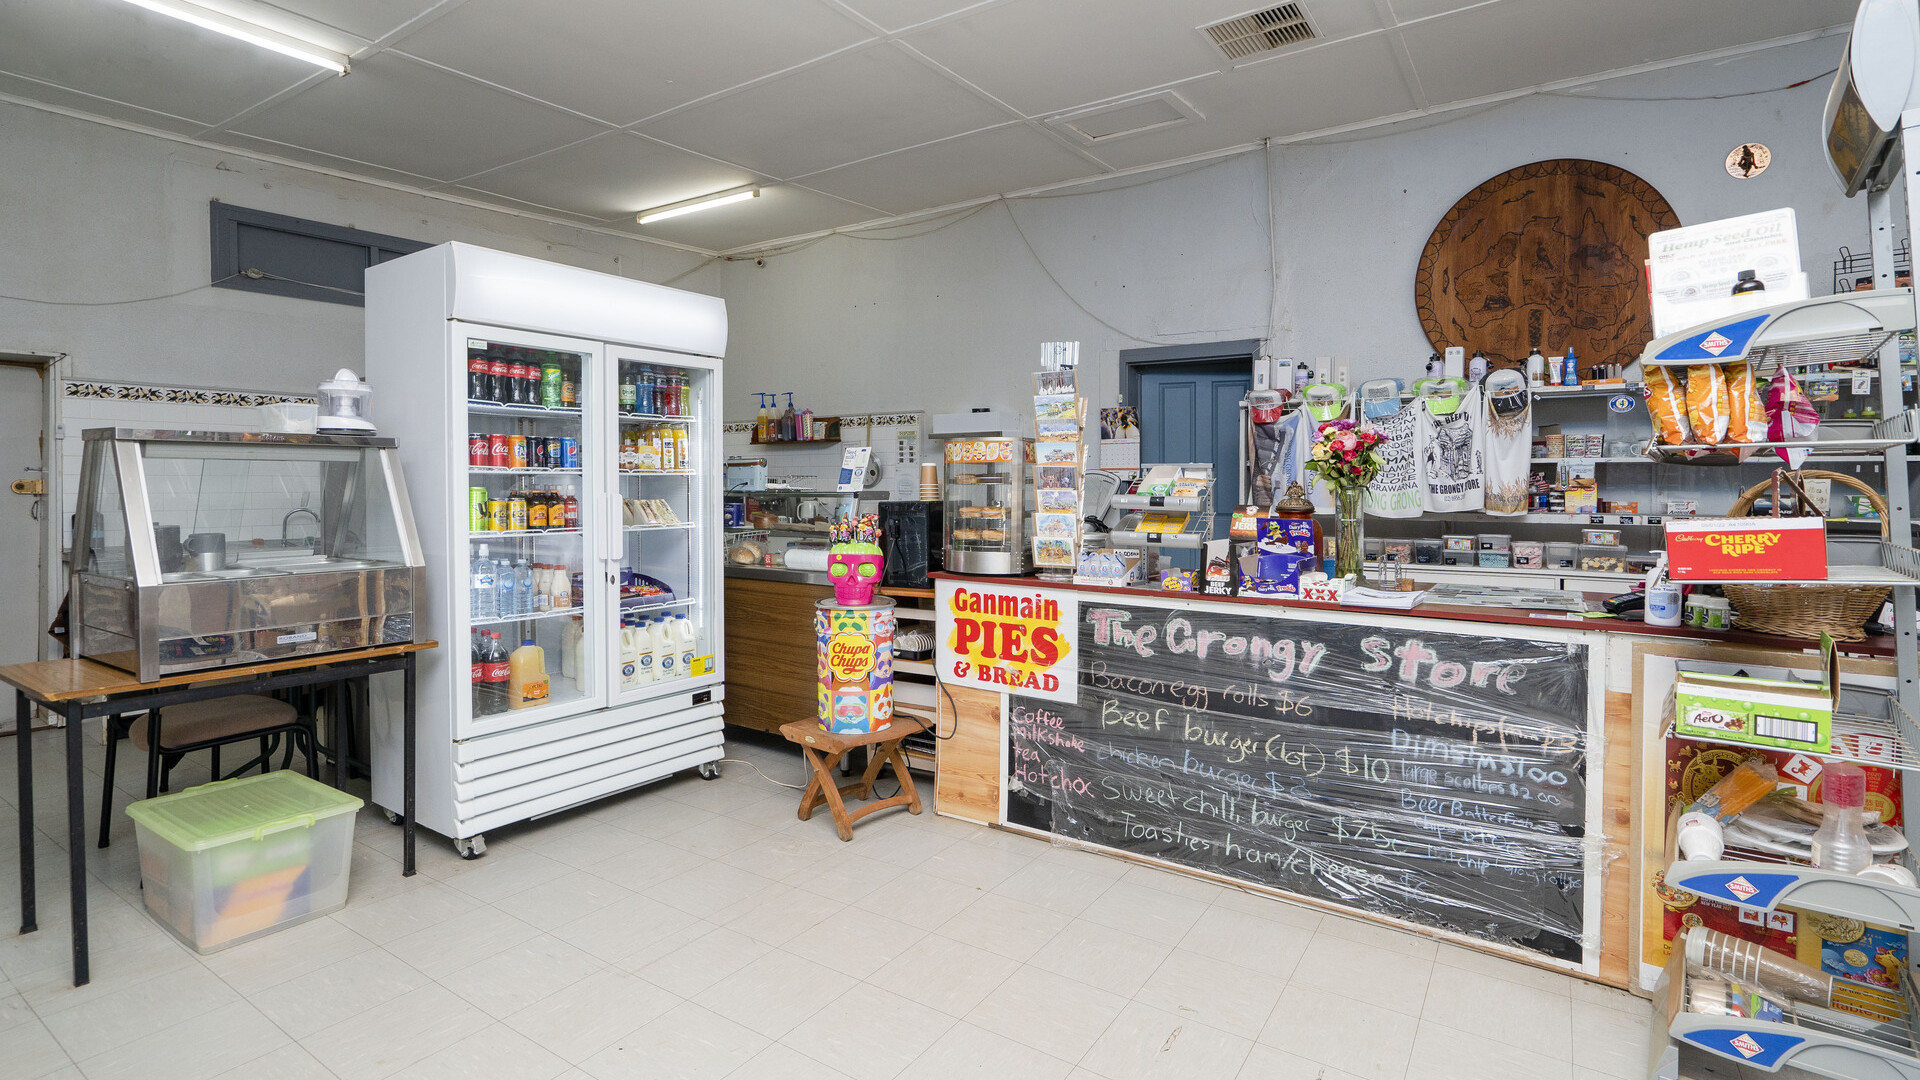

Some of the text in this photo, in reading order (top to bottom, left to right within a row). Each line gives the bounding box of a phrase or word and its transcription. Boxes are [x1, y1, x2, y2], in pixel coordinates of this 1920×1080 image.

[1662, 223, 1782, 252] Hemp Seed Oil
[1390, 490, 1421, 511] GRONG
[1233, 522, 1257, 531] JERK
[1289, 528, 1311, 537] Freddo
[1675, 532, 1782, 546] Cadbury CHERRY
[1722, 544, 1766, 557] RIPE
[1204, 586, 1232, 595] JERKY
[1276, 584, 1296, 592] Freddo
[954, 588, 1058, 621] Ganmain
[832, 642, 870, 657] Chupa
[953, 617, 1059, 666] PIES
[1086, 608, 1527, 696] The Grongy Store
[830, 654, 869, 674] Chups
[953, 661, 1059, 693] & BREAD
[1091, 660, 1313, 717] Bacon egg rolls $6
[1011, 706, 1065, 730] Coffee
[1693, 712, 1724, 724] Aero
[1012, 726, 1085, 753] Milkshake
[1101, 699, 1170, 731] Beef
[1184, 714, 1260, 763] burger
[1334, 745, 1390, 783] $10
[1012, 742, 1041, 763] tea
[1096, 741, 1176, 770] chicken
[1183, 749, 1257, 803] burger
[1101, 775, 1180, 806] Sweet
[1251, 797, 1312, 842] burger
[1401, 787, 1447, 814] Beer
[1121, 810, 1210, 851] Toasties
[1729, 884, 1756, 894] SMITHS
[1734, 1040, 1760, 1051] SMITHS
